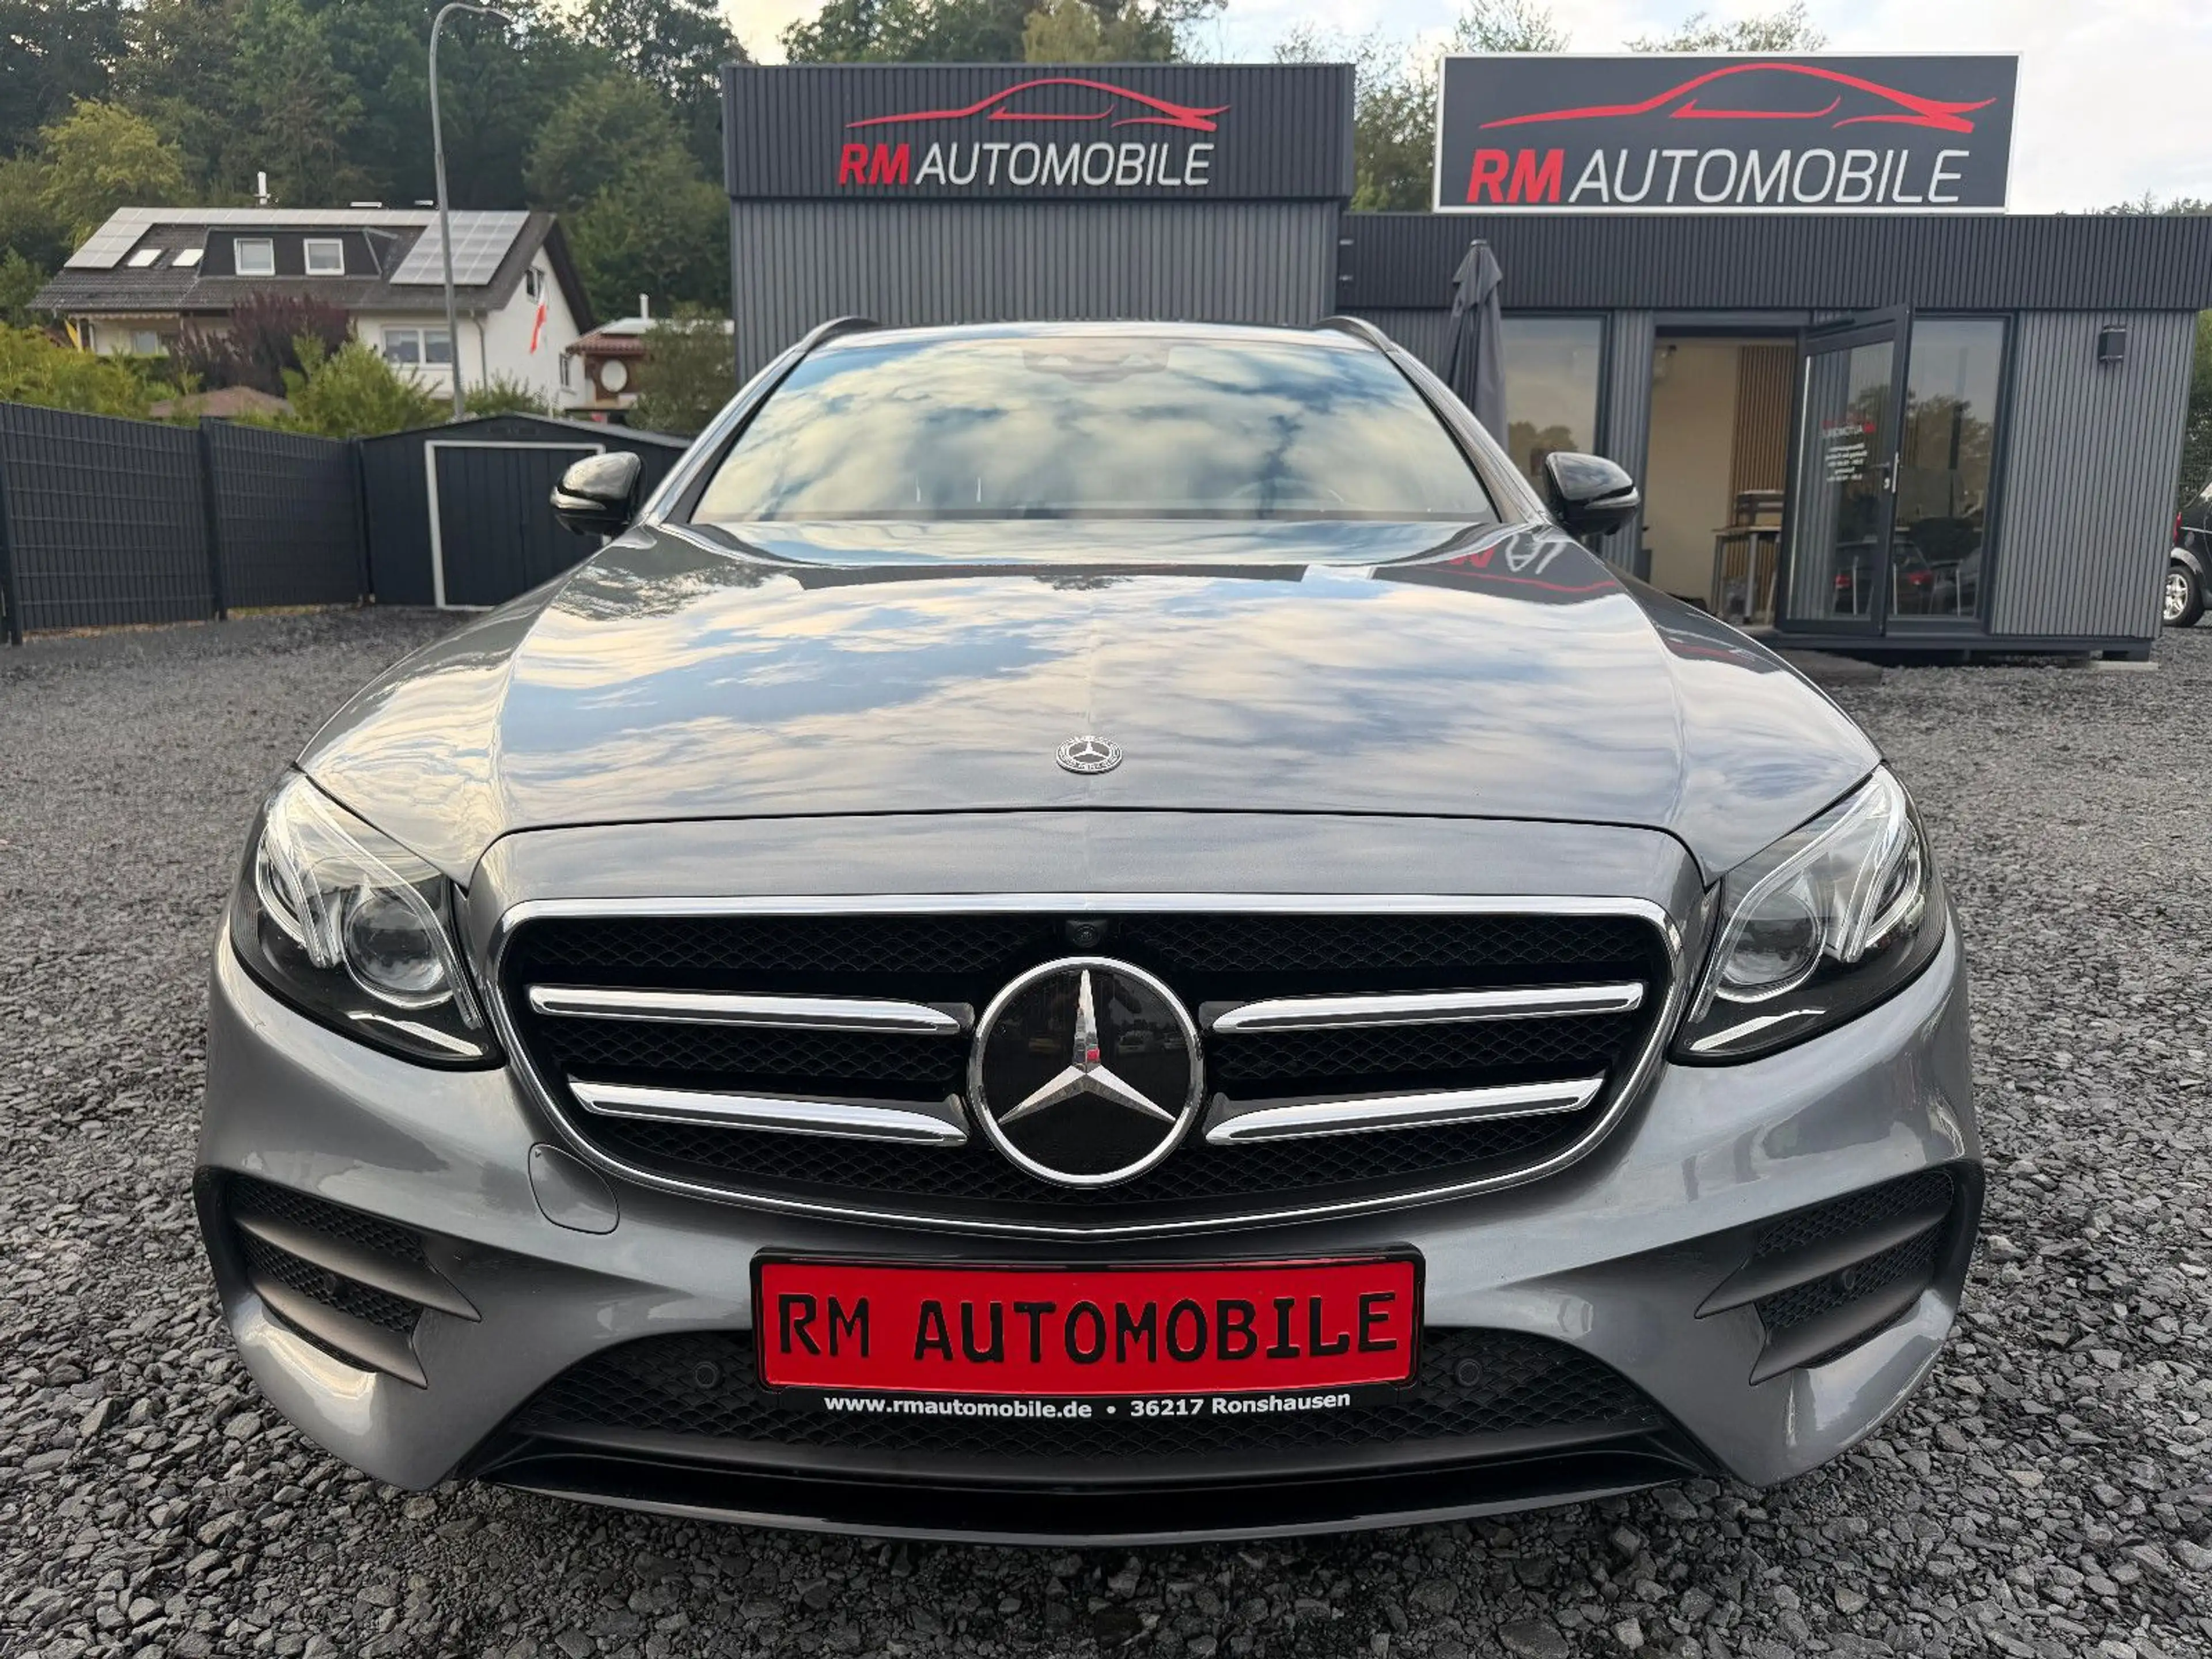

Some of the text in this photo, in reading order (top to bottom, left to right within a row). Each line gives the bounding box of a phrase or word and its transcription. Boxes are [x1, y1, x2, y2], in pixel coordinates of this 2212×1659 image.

[838, 142, 1215, 187] RM AUTOMOBILE
[1466, 149, 1969, 203] RM AUTOMOBILE
[778, 1291, 1397, 1363] RM AUTOMOBILE
[824, 1391, 1350, 1419] www.rmautomobile.de 36217 Ronshausen
